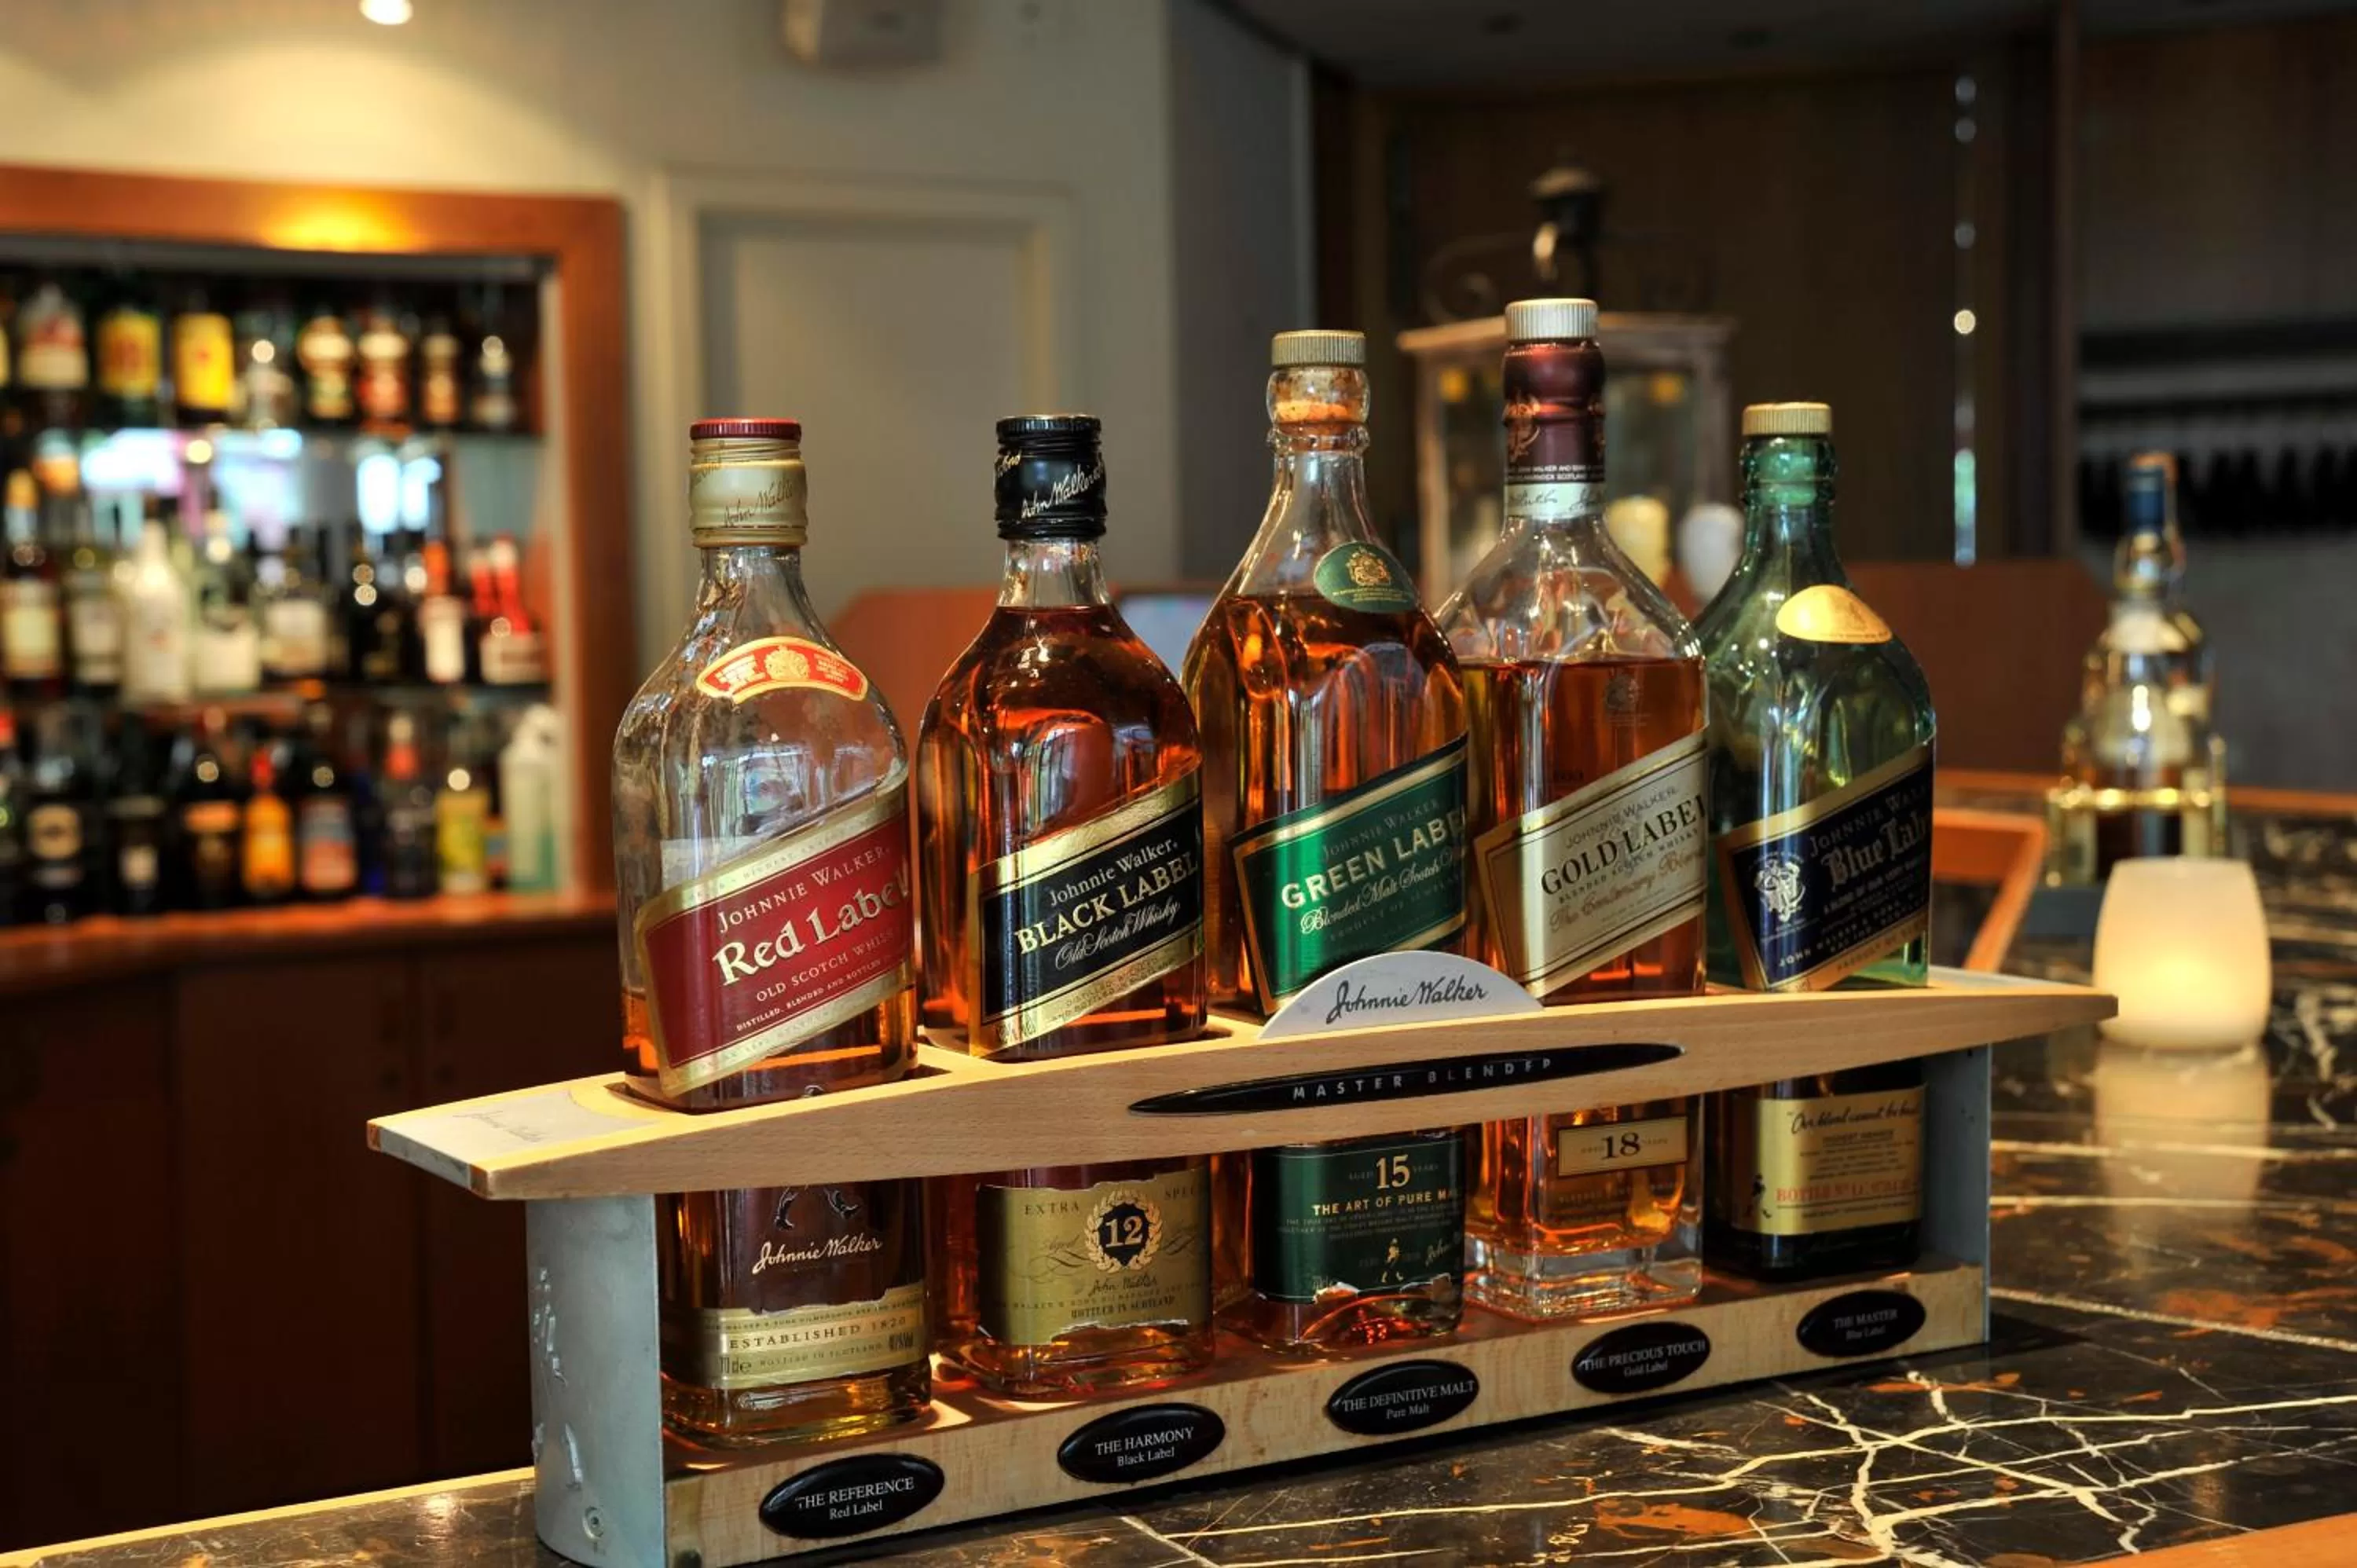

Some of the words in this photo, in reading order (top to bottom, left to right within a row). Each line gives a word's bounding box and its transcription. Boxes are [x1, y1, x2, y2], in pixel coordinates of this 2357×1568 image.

[1323, 826, 1383, 861] JOHNNIE
[1565, 812, 1621, 848] JOHNNIE
[1541, 840, 1619, 896] GOLD
[1820, 838, 1886, 893] Blue
[1879, 810, 1926, 862] Lab
[1050, 866, 1116, 906] Johnnie
[1281, 846, 1387, 909] GREEN
[718, 881, 808, 934] JOHNNIE
[1014, 892, 1116, 954] BLACK
[1117, 851, 1198, 909] LABEL
[712, 920, 806, 986] Red
[805, 856, 909, 945] Label
[1055, 940, 1087, 970] Old
[1083, 921, 1131, 956] Scotch
[756, 982, 786, 1002] OLD
[791, 951, 849, 987] SCOTCH
[852, 929, 893, 956] WHIS
[1325, 980, 1412, 1024] Johnnie
[1409, 973, 1490, 1009] Walker
[1293, 1074, 1403, 1100] MASTER
[1427, 1057, 1552, 1084] BLENDER
[1601, 1132, 1641, 1160] 18
[1376, 1154, 1411, 1190] 15
[1024, 1200, 1080, 1215] EXTRA
[1311, 1203, 1340, 1217] THE
[1345, 1198, 1370, 1213] ART
[1376, 1196, 1392, 1207] OF
[1398, 1191, 1432, 1206] PURE
[1105, 1214, 1144, 1248] 12
[752, 1240, 822, 1275] Johnnie
[820, 1232, 883, 1258] Walker
[1071, 1304, 1115, 1319] BOTTLED
[1118, 1303, 1127, 1313] IN
[730, 1324, 861, 1349] ESTABLISHED
[871, 1316, 906, 1332] 1820
[1583, 1357, 1607, 1372] THE
[1609, 1346, 1665, 1367] PRECIOUS
[1667, 1339, 1706, 1357] TOUCH
[1646, 1359, 1669, 1373] Label
[1342, 1397, 1368, 1412] THE
[1369, 1385, 1439, 1408] DEFINITIVE
[1440, 1379, 1475, 1396] MALT
[1385, 1408, 1406, 1420] Pure
[1409, 1404, 1431, 1416] Malt
[1095, 1439, 1123, 1456] THE
[1125, 1426, 1195, 1451] HARMONY
[1116, 1453, 1146, 1467] Black
[1147, 1447, 1175, 1462] Label
[794, 1493, 825, 1509] THE
[829, 1476, 915, 1505] REFERENCE
[829, 1504, 850, 1521] Red
[852, 1500, 884, 1516] Label
